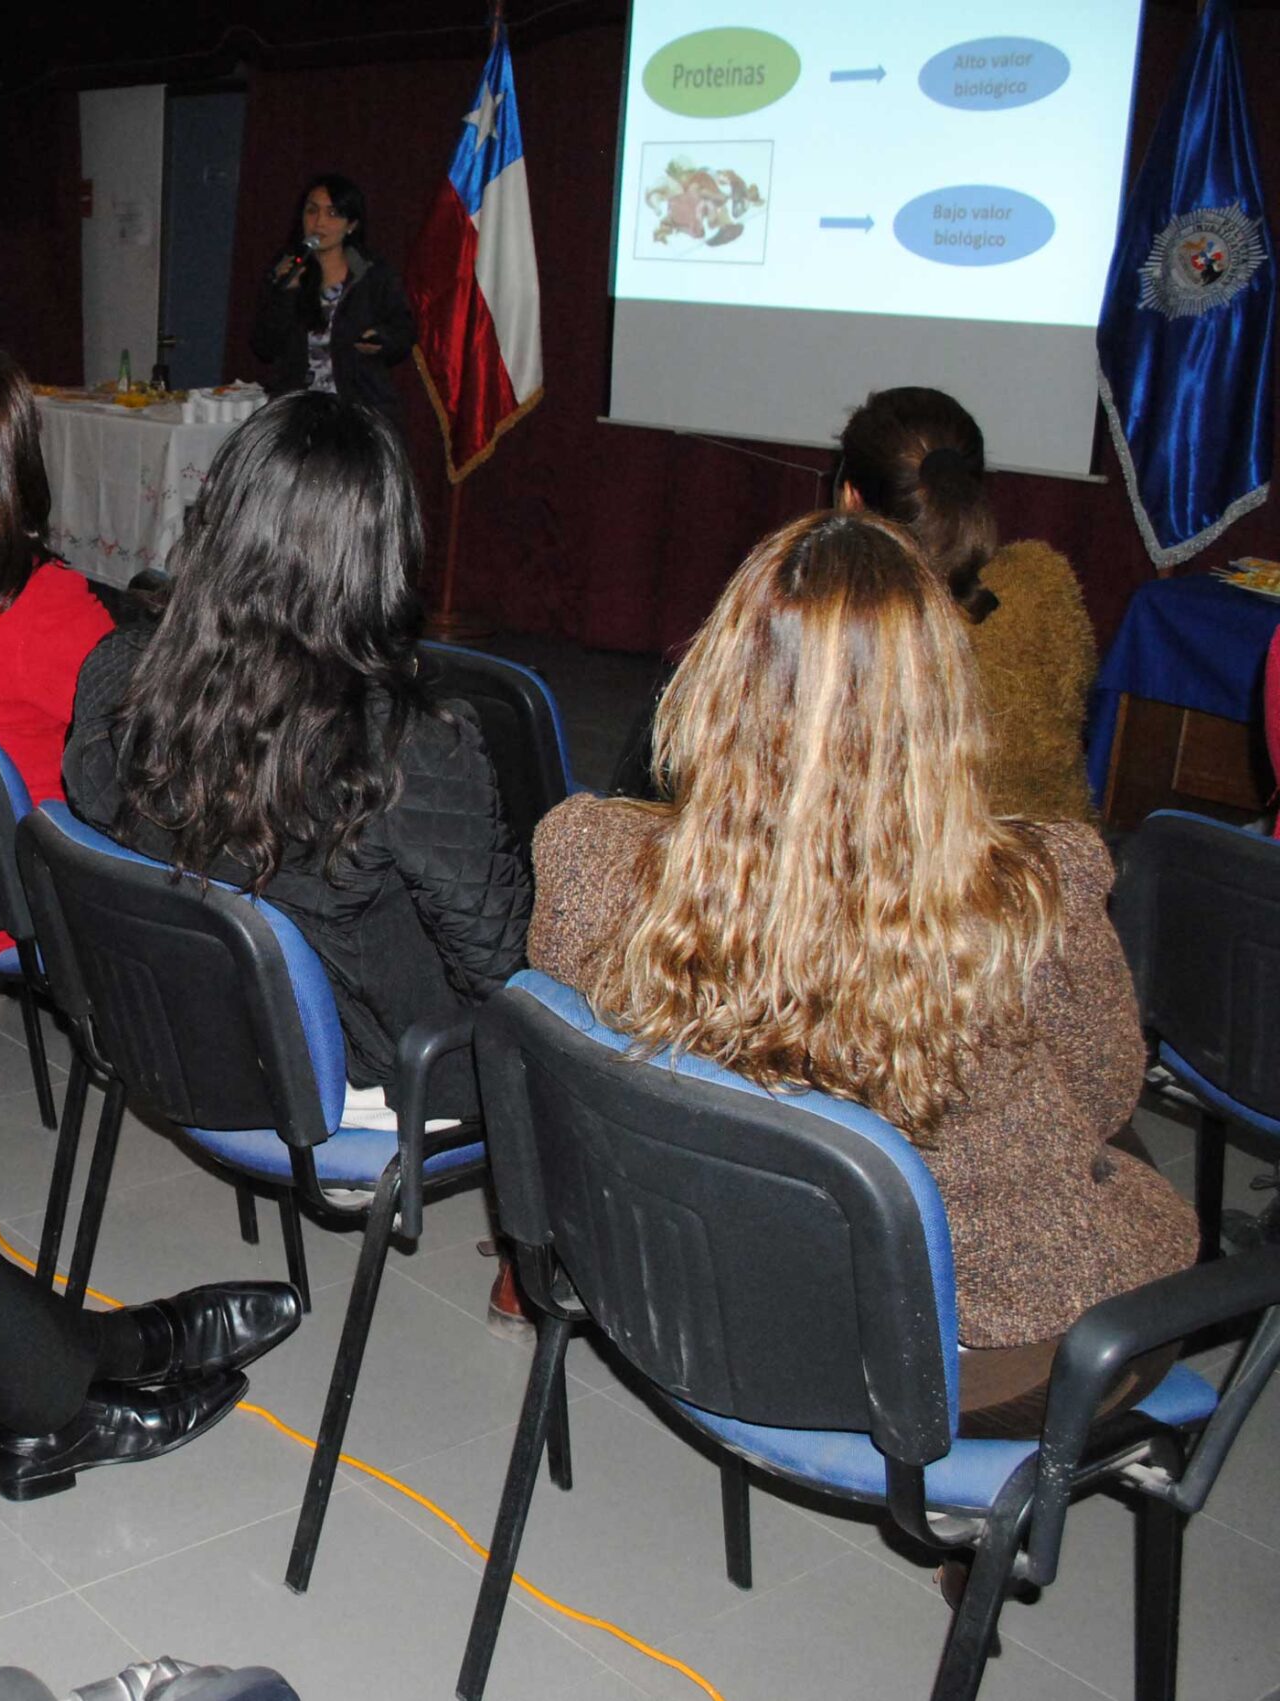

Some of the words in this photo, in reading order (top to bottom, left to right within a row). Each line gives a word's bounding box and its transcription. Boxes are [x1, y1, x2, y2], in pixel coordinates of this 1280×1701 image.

[952, 53, 987, 70] Alto
[991, 51, 1035, 69] valor
[672, 58, 766, 89] Proteínas
[954, 77, 1028, 100] biológico
[932, 203, 967, 223] Bajo
[971, 203, 1013, 221] valor
[933, 229, 1006, 251] biológico
